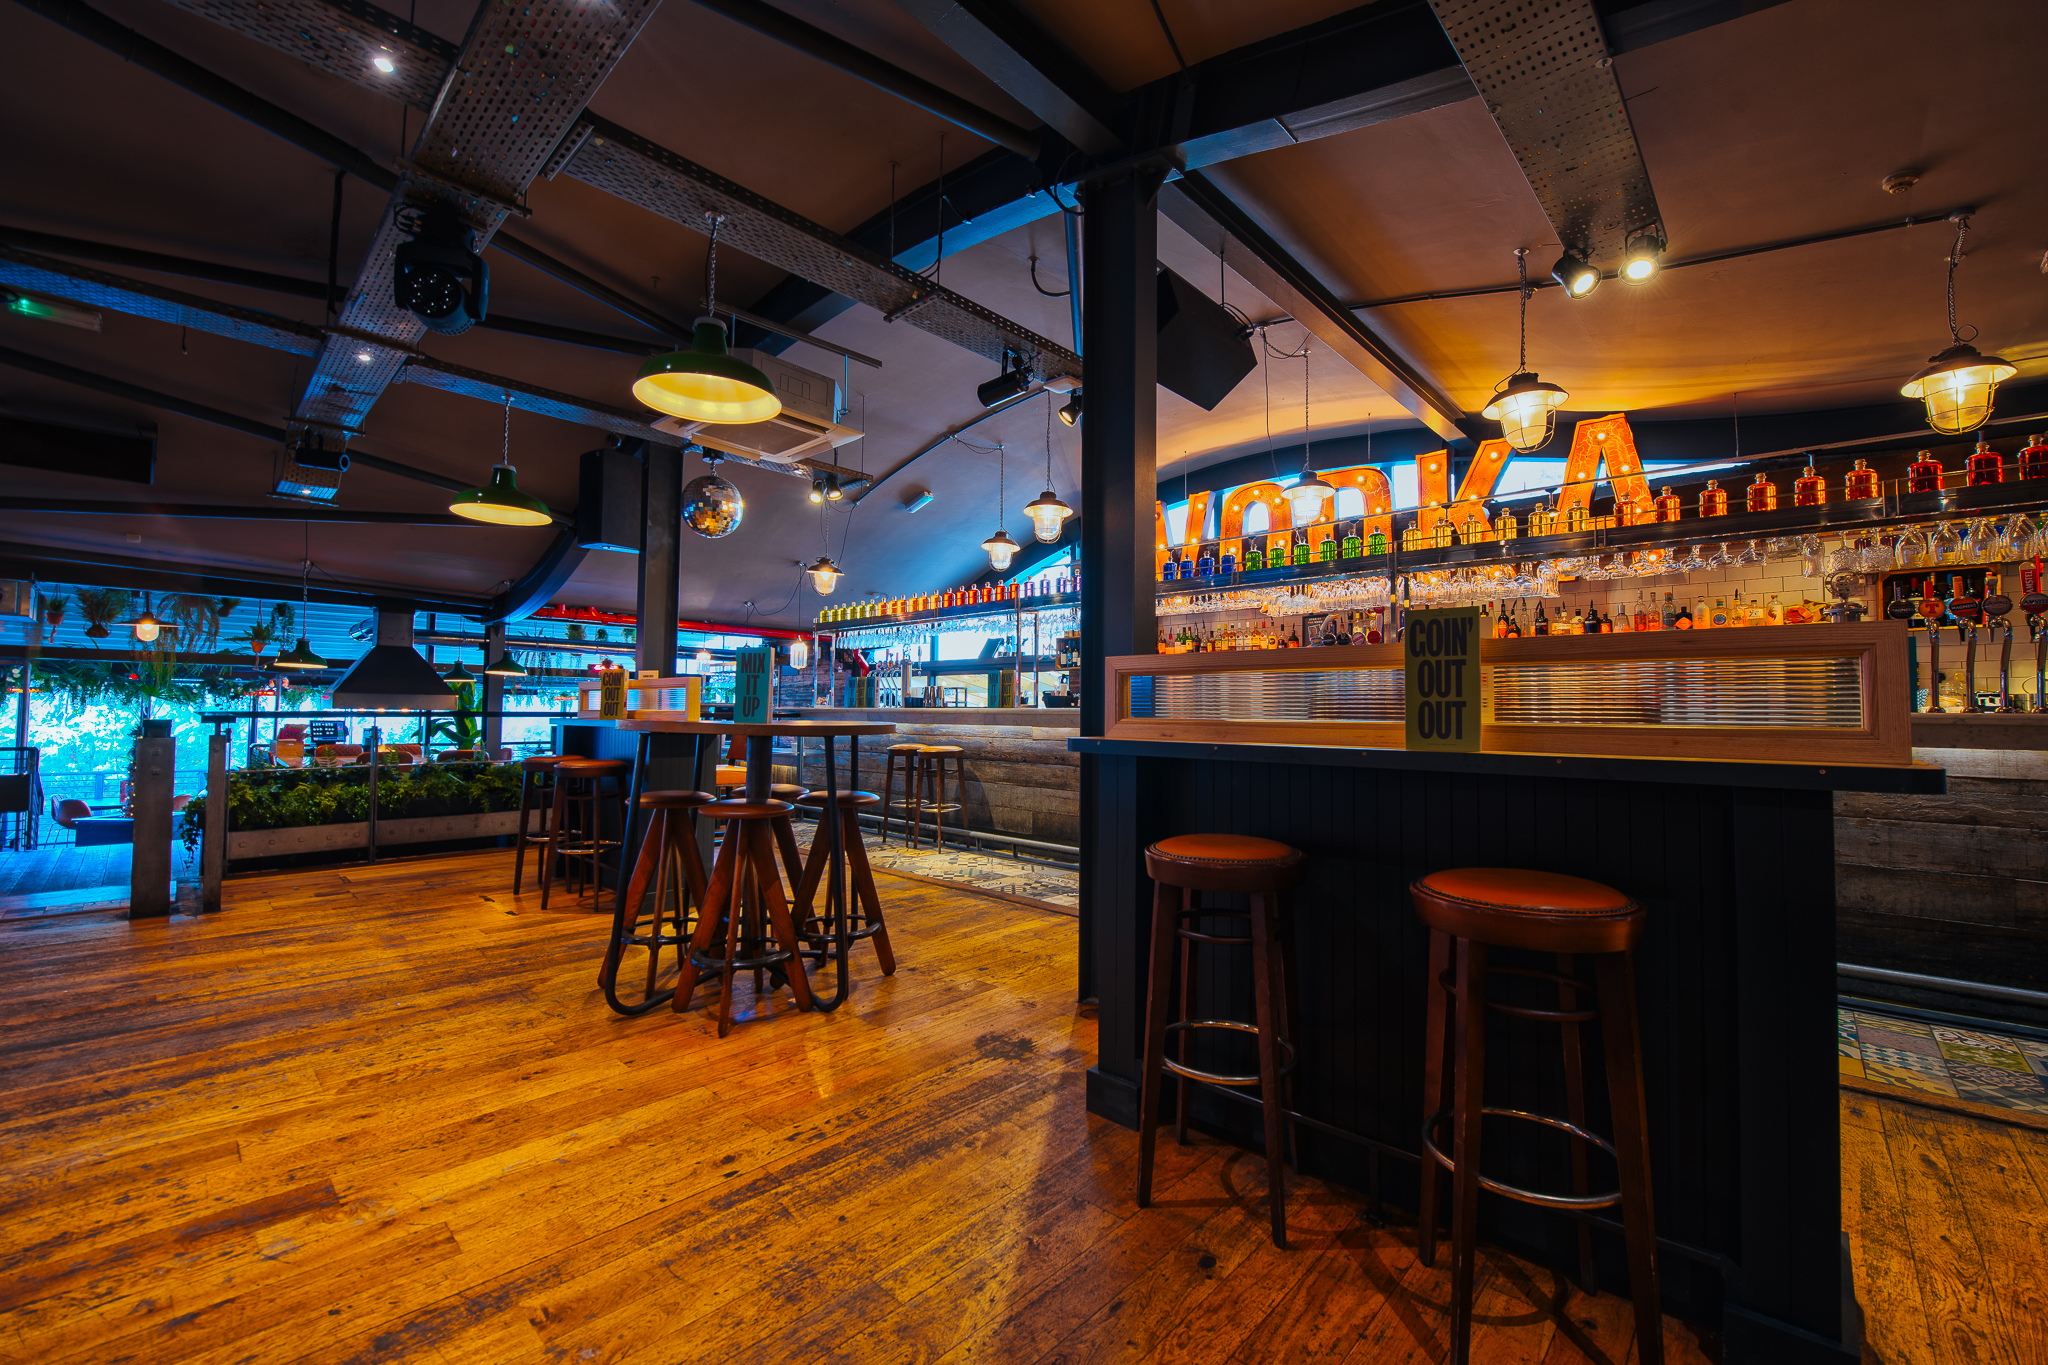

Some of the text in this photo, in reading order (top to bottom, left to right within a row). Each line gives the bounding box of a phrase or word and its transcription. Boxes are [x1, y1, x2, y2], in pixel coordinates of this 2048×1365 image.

[2024, 570, 2034, 593] AMSTEL
[1925, 603, 1940, 614] T
[1409, 617, 1473, 657] GOIN'
[741, 653, 766, 673] MIX
[746, 675, 759, 695] IT
[1417, 659, 1467, 698] OUT
[605, 687, 620, 701] OUT
[604, 702, 619, 716] OUT
[742, 696, 760, 717] UP
[1417, 701, 1467, 739] OUT
